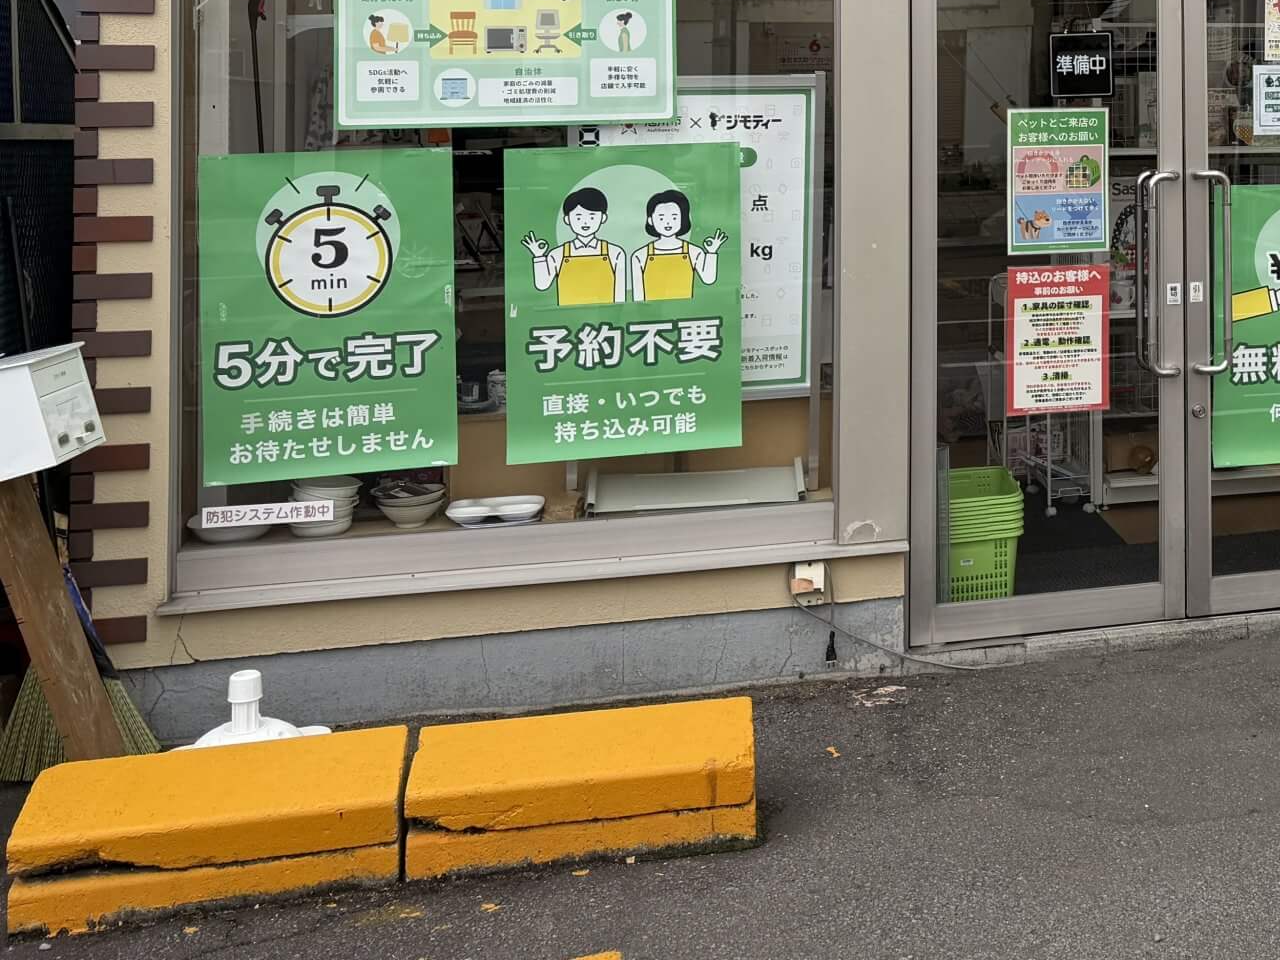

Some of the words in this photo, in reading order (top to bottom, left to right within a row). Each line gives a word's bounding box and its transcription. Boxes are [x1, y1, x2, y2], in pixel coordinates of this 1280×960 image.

[1056, 54, 1106, 76] 準備中
[726, 114, 782, 130] ジモティー
[1018, 117, 1098, 128] ペットとご来店の
[1018, 131, 1099, 143] お客様へのお願い
[750, 194, 769, 212] 点
[311, 227, 349, 270] 5
[750, 242, 773, 261] kg
[311, 274, 348, 291] min
[1016, 269, 1101, 285] 持込のお客様へ
[527, 316, 723, 372] 予約不要
[215, 330, 441, 390] 5分で完了
[542, 385, 707, 417] 直接・いつでも
[241, 403, 396, 435] 手続きは簡単
[554, 412, 697, 444] 持ち込み可能
[229, 428, 434, 465] お待たせしません
[205, 503, 331, 525] 防犯システム作動中
